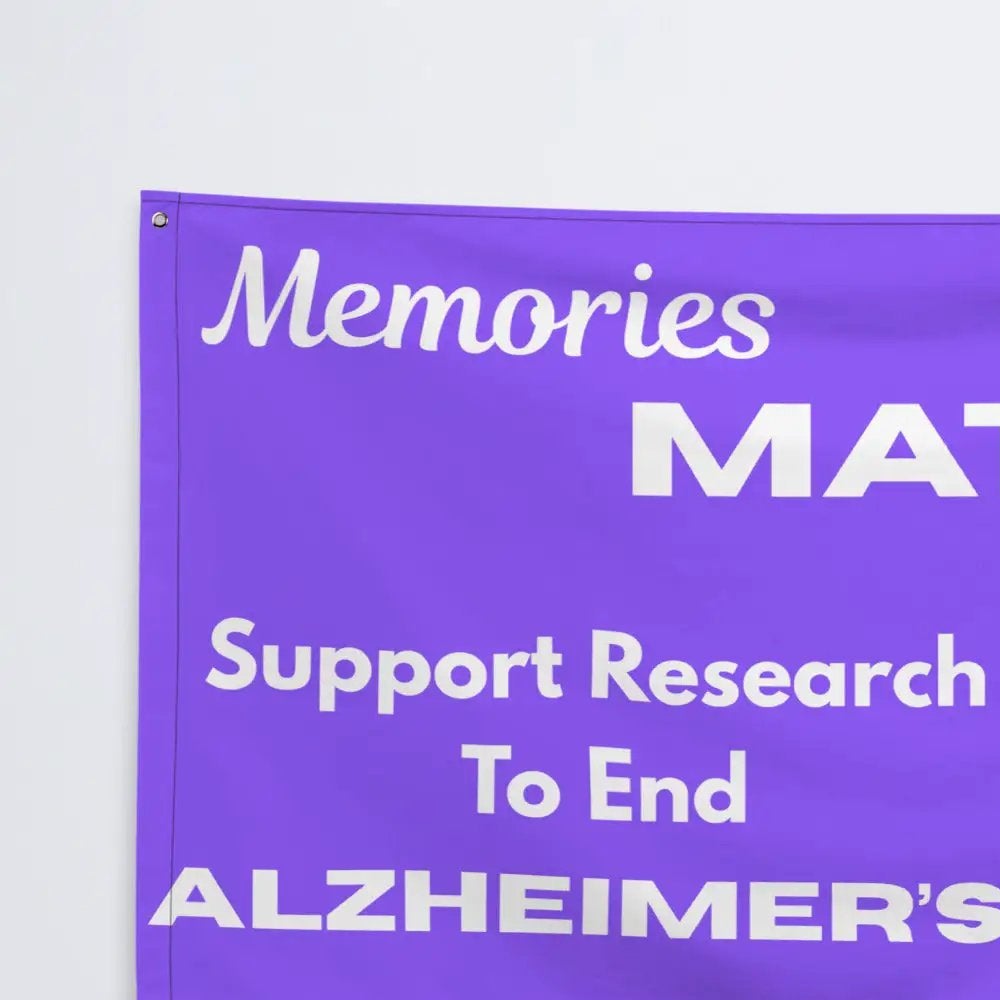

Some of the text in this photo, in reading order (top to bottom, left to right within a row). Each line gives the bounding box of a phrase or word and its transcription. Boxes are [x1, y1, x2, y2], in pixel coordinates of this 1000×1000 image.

[201, 244, 775, 360] Memories
[206, 617, 987, 715] Support Research
[460, 743, 747, 824] To End
